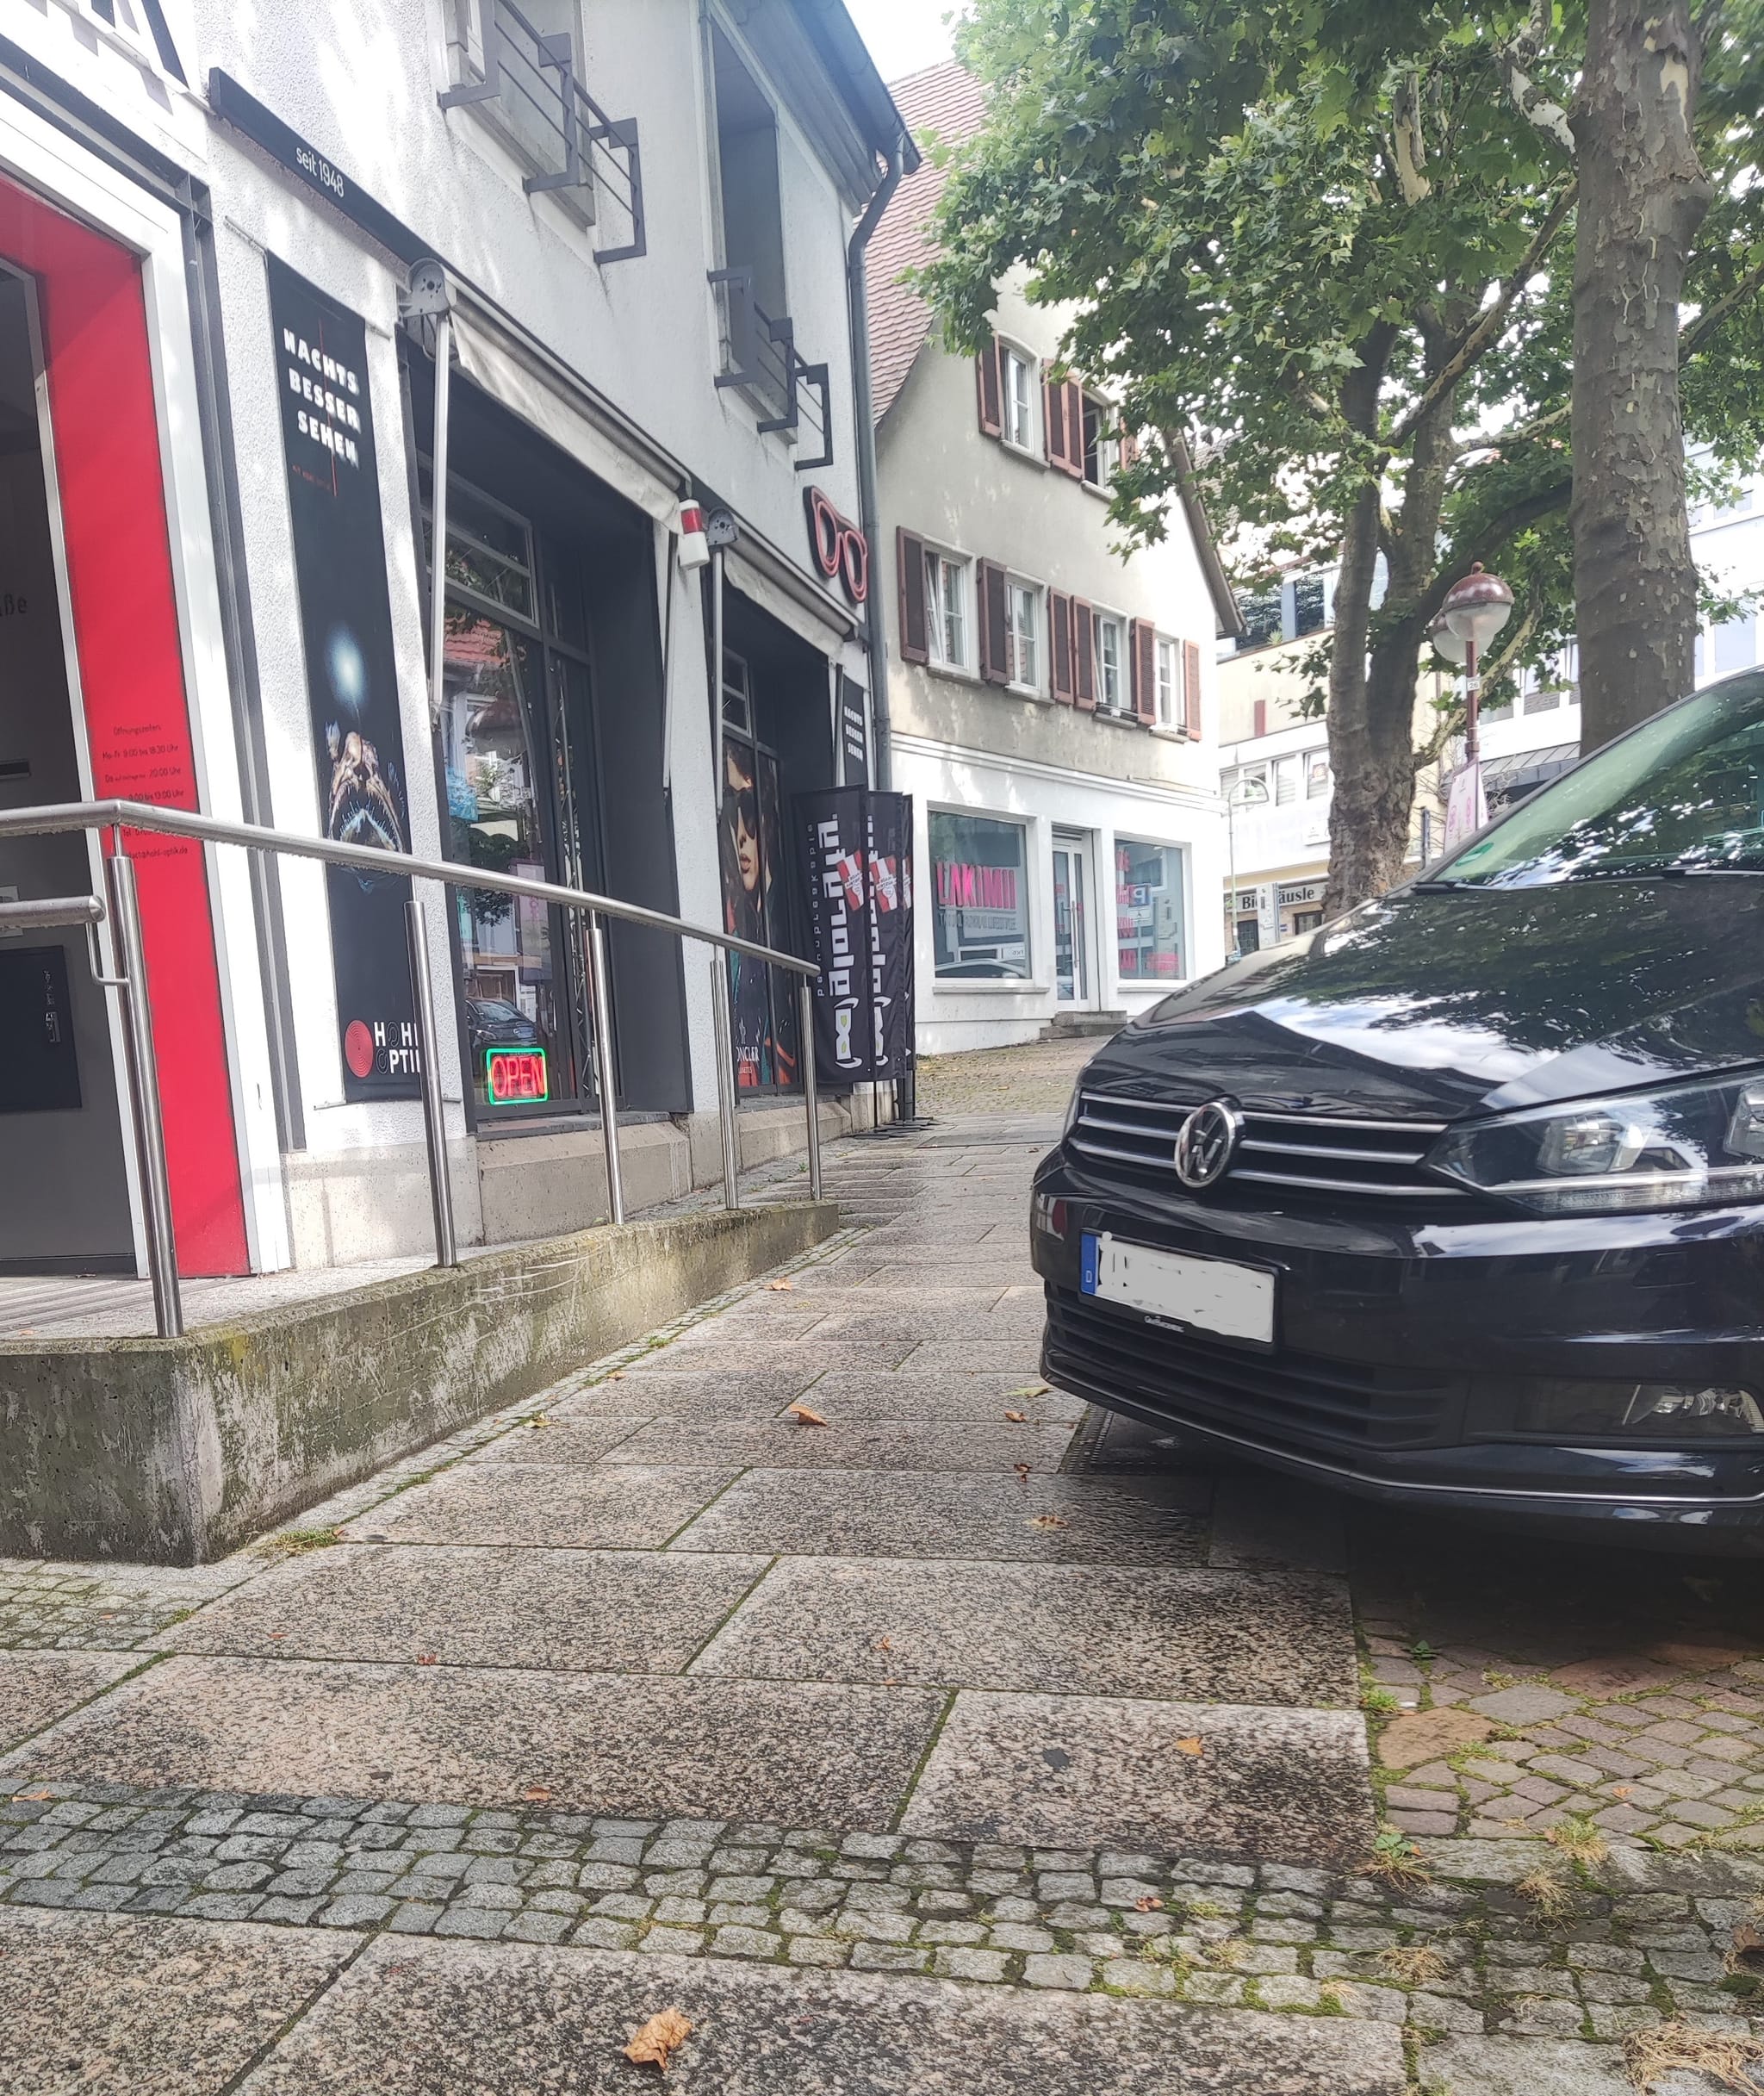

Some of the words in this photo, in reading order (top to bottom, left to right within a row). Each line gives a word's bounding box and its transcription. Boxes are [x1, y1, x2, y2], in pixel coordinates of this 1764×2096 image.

[296, 147, 317, 177] seit
[319, 159, 345, 198] 1948
[283, 327, 360, 397] NACHTS
[289, 368, 361, 434] BESSER
[297, 410, 359, 470] SEHEN
[491, 1054, 544, 1098] OPEN
[1085, 1270, 1093, 1284] D
